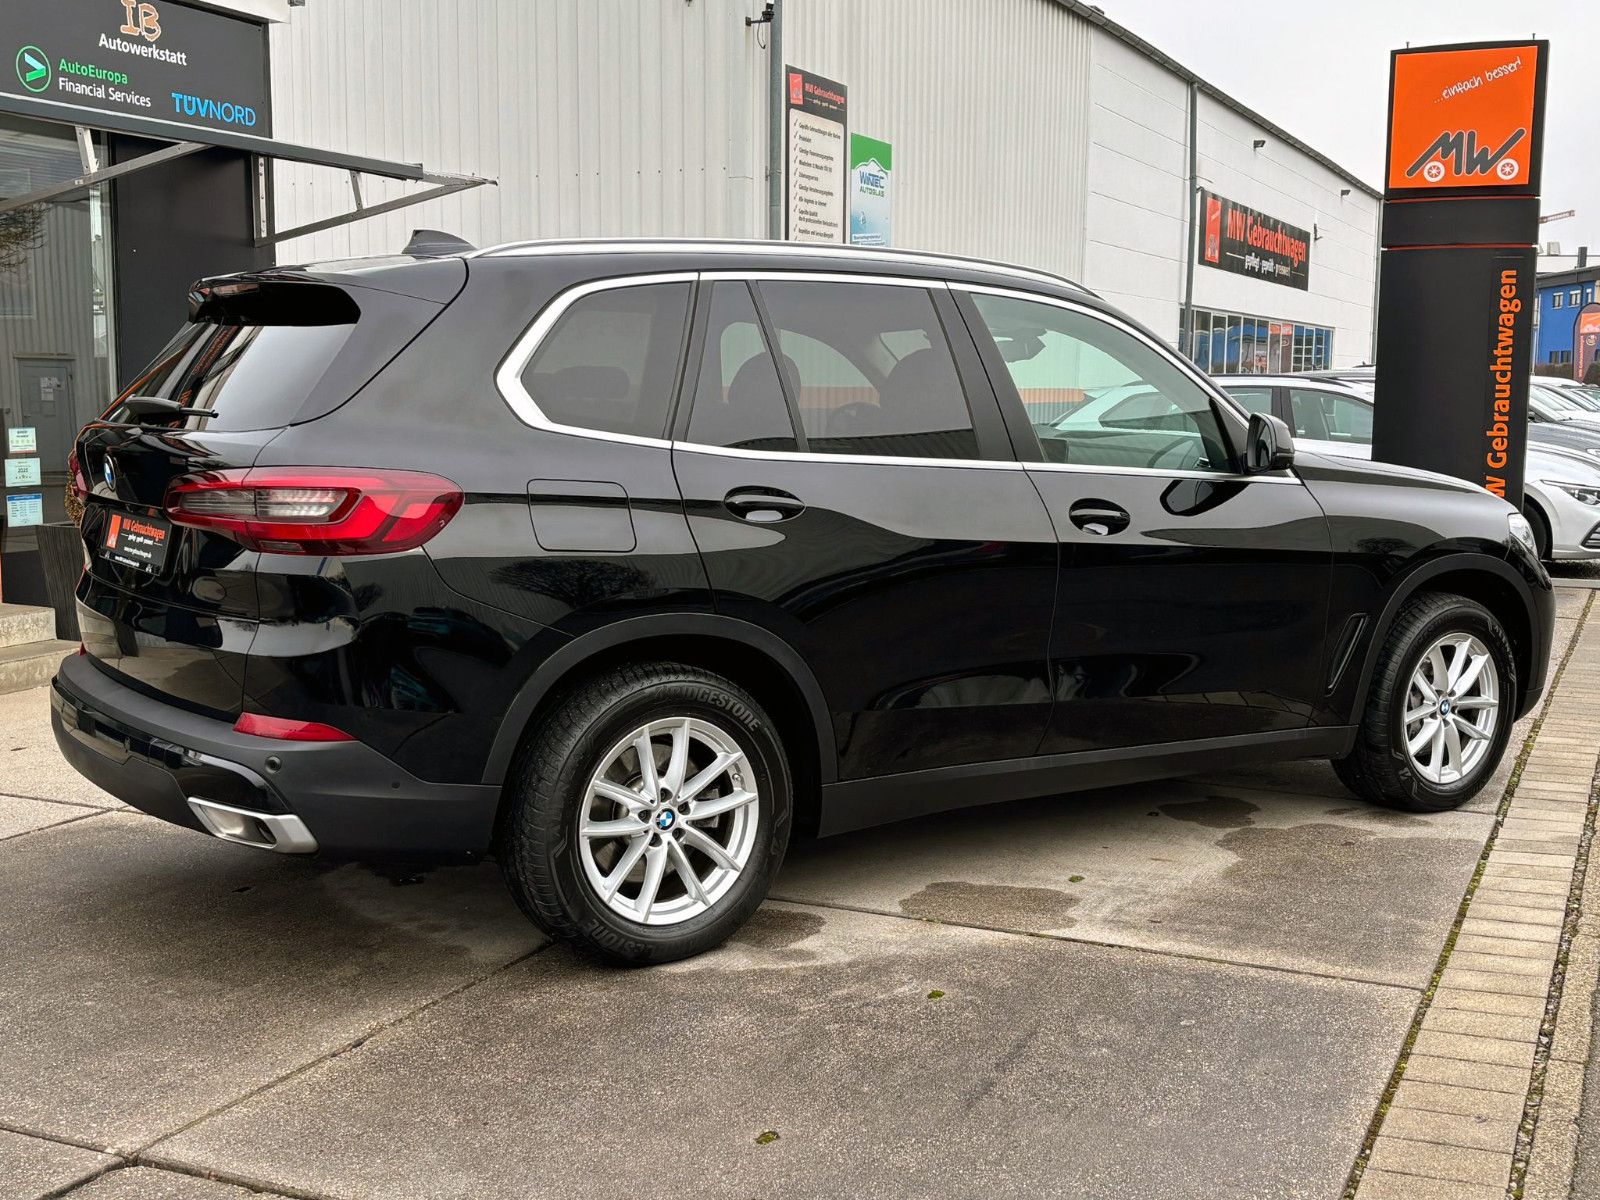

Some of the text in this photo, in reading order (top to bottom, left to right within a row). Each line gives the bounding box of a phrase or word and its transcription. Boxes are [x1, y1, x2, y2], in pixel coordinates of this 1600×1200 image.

[99, 33, 188, 67] Autowerkstatt
[59, 58, 128, 85] AutoEuropa
[58, 78, 152, 108] Financial Services
[1405, 127, 1527, 178] MW
[1227, 208, 1307, 268] MW Gebrauchtwagen
[1485, 268, 1522, 498] W Gebrauchtwagen
